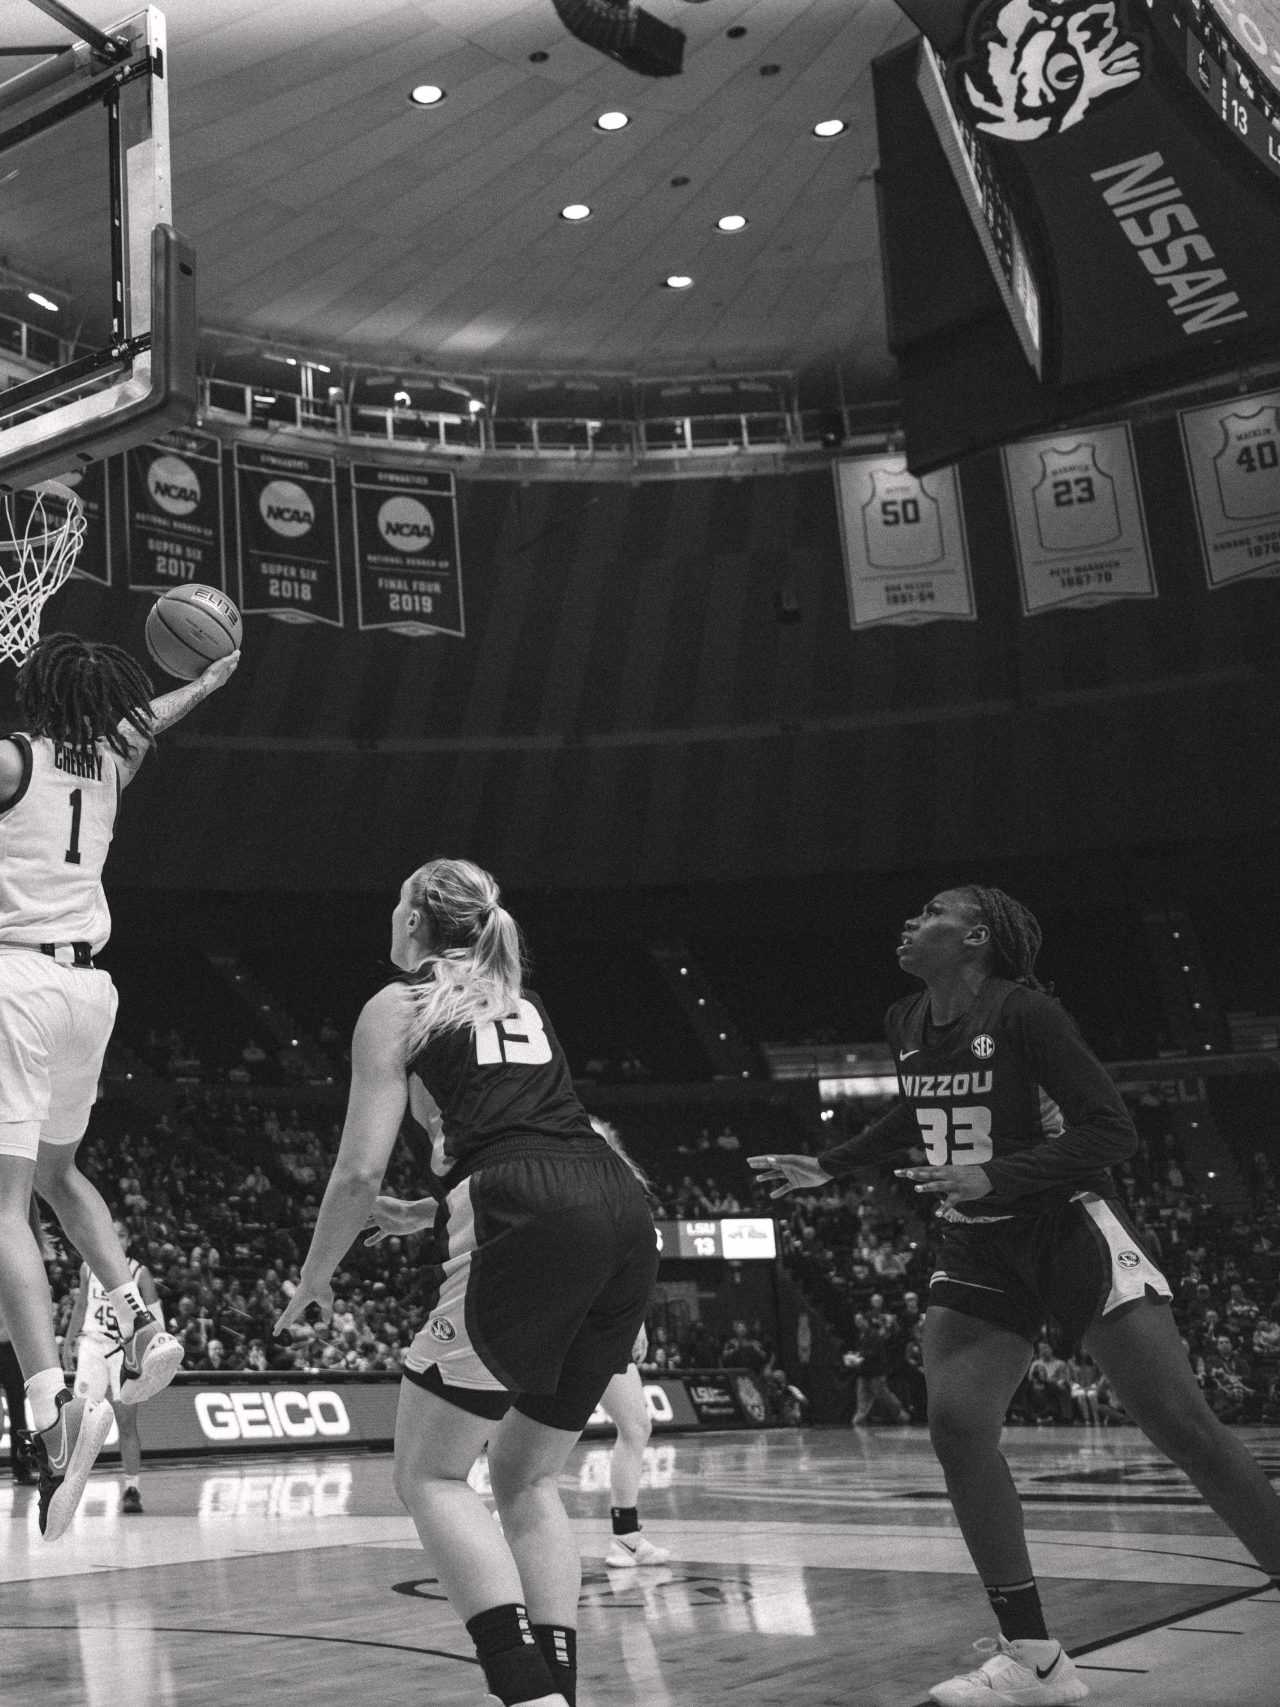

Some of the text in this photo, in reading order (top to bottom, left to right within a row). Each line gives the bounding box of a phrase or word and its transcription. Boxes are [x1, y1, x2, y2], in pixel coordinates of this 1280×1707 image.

[1231, 99, 1248, 135] 13
[1090, 151, 1248, 334] NISSAN
[1236, 440, 1278, 473] 40
[154, 481, 200, 502] NCAA
[1052, 477, 1096, 508] 23
[266, 505, 314, 525] NCAA
[881, 499, 920, 526] 50
[385, 520, 435, 539] NCAA
[156, 555, 196, 580] 2017
[261, 562, 297, 578] SUPER
[269, 578, 313, 601] 2018
[377, 577, 410, 591] FINAL
[194, 591, 238, 627] ELITE
[388, 593, 433, 613] 2019
[54, 743, 103, 782] CHERRY
[64, 788, 82, 865] 1
[475, 998, 553, 1065] 13
[973, 1036, 993, 1058] SEC
[915, 1106, 994, 1167] 33
[693, 1237, 716, 1257] 13
[94, 1305, 117, 1330] 45
[194, 1390, 351, 1440] GEICO
